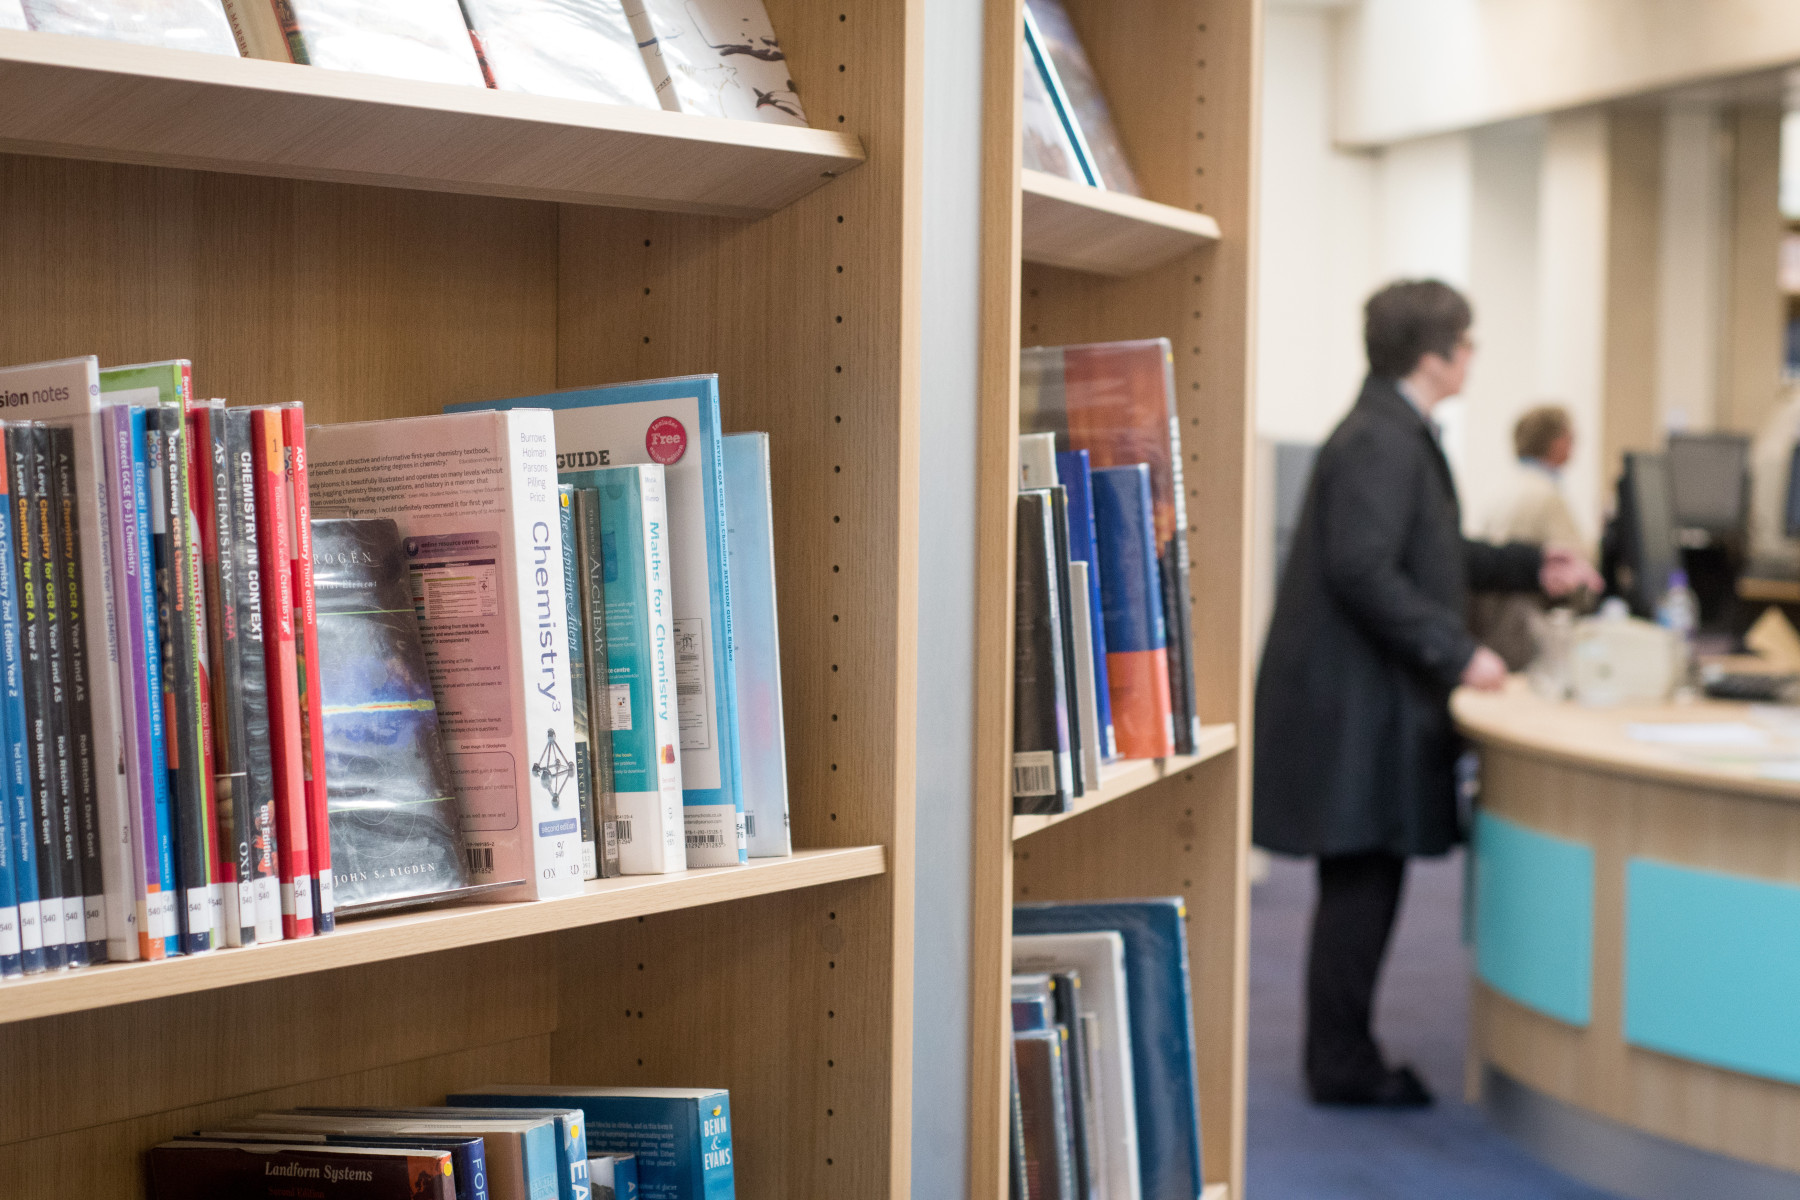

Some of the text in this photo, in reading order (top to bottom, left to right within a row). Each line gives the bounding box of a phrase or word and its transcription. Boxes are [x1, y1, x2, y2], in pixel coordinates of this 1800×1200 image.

[32, 386, 69, 402] notes
[182, 375, 190, 412] Revision
[520, 432, 547, 443] Burrows
[651, 433, 680, 445] Free
[295, 446, 304, 471] AQA
[523, 448, 546, 457] Holman
[556, 450, 610, 469] GUIDE
[16, 464, 26, 496] Level
[523, 462, 549, 473] Parsons
[36, 465, 46, 496] Level
[60, 465, 69, 496] Level
[135, 462, 146, 509] Edexcel
[527, 477, 546, 490] Pilling
[97, 483, 106, 507] AQA
[118, 431, 136, 577] Edexcel GCSE (9-1) Chemistry
[529, 492, 546, 502] Price
[17, 498, 31, 559] Chemistry
[38, 499, 51, 559] Chemistry
[61, 499, 74, 558] Chemistry
[168, 437, 184, 611] OCR Gateway GCSE Chemistry
[298, 506, 309, 561] Chemistry
[214, 443, 235, 640] AS CHEMISTRY AQA
[240, 451, 261, 642] CHEMISTRY IN CONTEXT
[23, 560, 32, 579] for
[44, 560, 53, 579] for
[67, 560, 75, 578] for
[303, 563, 311, 585] Third
[561, 533, 575, 600] Aspiring
[24, 580, 33, 608] OCR
[68, 581, 77, 607] OCR
[103, 570, 112, 593] Year
[45, 581, 55, 608] OCR
[589, 556, 605, 657] ALCHEMY
[1, 600, 11, 621] 2nd
[144, 594, 154, 625] GCSE
[305, 590, 313, 625] edition
[105, 602, 117, 662] CHEMISTRY
[566, 603, 579, 652] Adept
[649, 521, 669, 720] Maths for Chemistry
[3, 623, 14, 661] Edition
[27, 623, 37, 650] Year
[48, 623, 58, 649] Year
[71, 622, 80, 649] Year
[146, 628, 156, 653] and
[7, 662, 16, 688] Year
[51, 660, 60, 683] and
[74, 659, 82, 681] and
[53, 685, 61, 702] AS
[75, 683, 84, 701] AS
[148, 655, 160, 722] Certificate
[201, 702, 209, 726] David
[34, 718, 50, 844] Rob Ritchie Dave Gent
[152, 738, 166, 805] Chemistry
[575, 751, 586, 811] PRINCIPE
[13, 742, 28, 861] Ted Lister Janet Renshaw
[57, 735, 73, 859] Rob Ritchie Dave Gent
[79, 734, 94, 857] Rob Ritchie Dave Gent
[121, 825, 129, 843] King
[260, 803, 272, 867] 6th Edition
[542, 822, 576, 834] second edition
[333, 862, 436, 888] JOHN S. RIGDEN
[258, 891, 270, 900] 540
[294, 890, 306, 898] 540
[42, 914, 56, 923] 540
[66, 912, 78, 921] 540
[86, 910, 99, 919] 540
[148, 908, 161, 916] 540
[188, 903, 201, 912] 540
[0, 924, 13, 932] 540
[22, 918, 35, 926] 540
[704, 1116, 727, 1138] BENN
[711, 1138, 722, 1150] &
[264, 1162, 373, 1183] Landform Systems
[704, 1150, 731, 1170] EVANS
